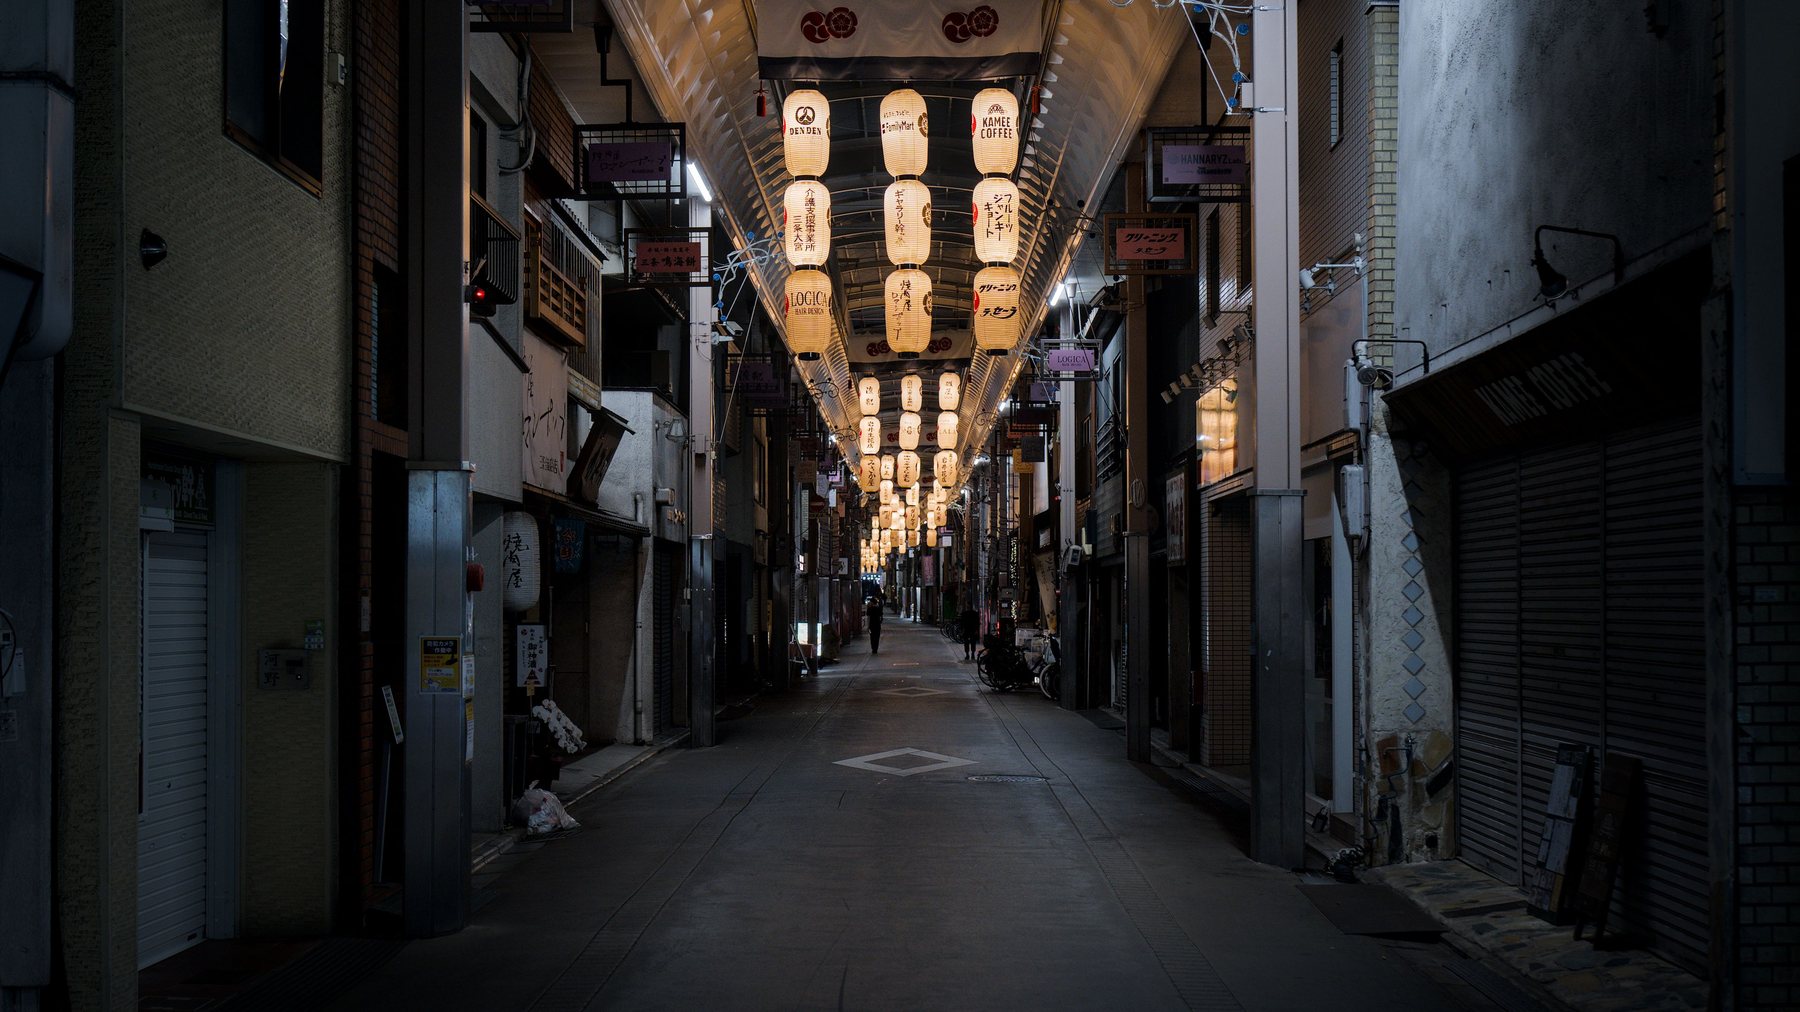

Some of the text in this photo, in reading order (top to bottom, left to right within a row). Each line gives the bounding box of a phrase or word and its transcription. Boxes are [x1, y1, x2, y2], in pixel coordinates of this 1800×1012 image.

[982, 117, 1011, 128] KAMEE
[980, 127, 1013, 139] COFFEE
[1180, 153, 1228, 165] HANNARYZ
[984, 202, 994, 239] キョート
[994, 193, 1004, 241] ジャンキー
[1004, 193, 1013, 233] フルーツ
[790, 291, 829, 307] LOGICA
[794, 307, 825, 316] HAIR DESIGN
[1057, 355, 1087, 364] LOGICA
[1525, 351, 1614, 411] COFFEE
[503, 533, 530, 591] 焼肉屋
